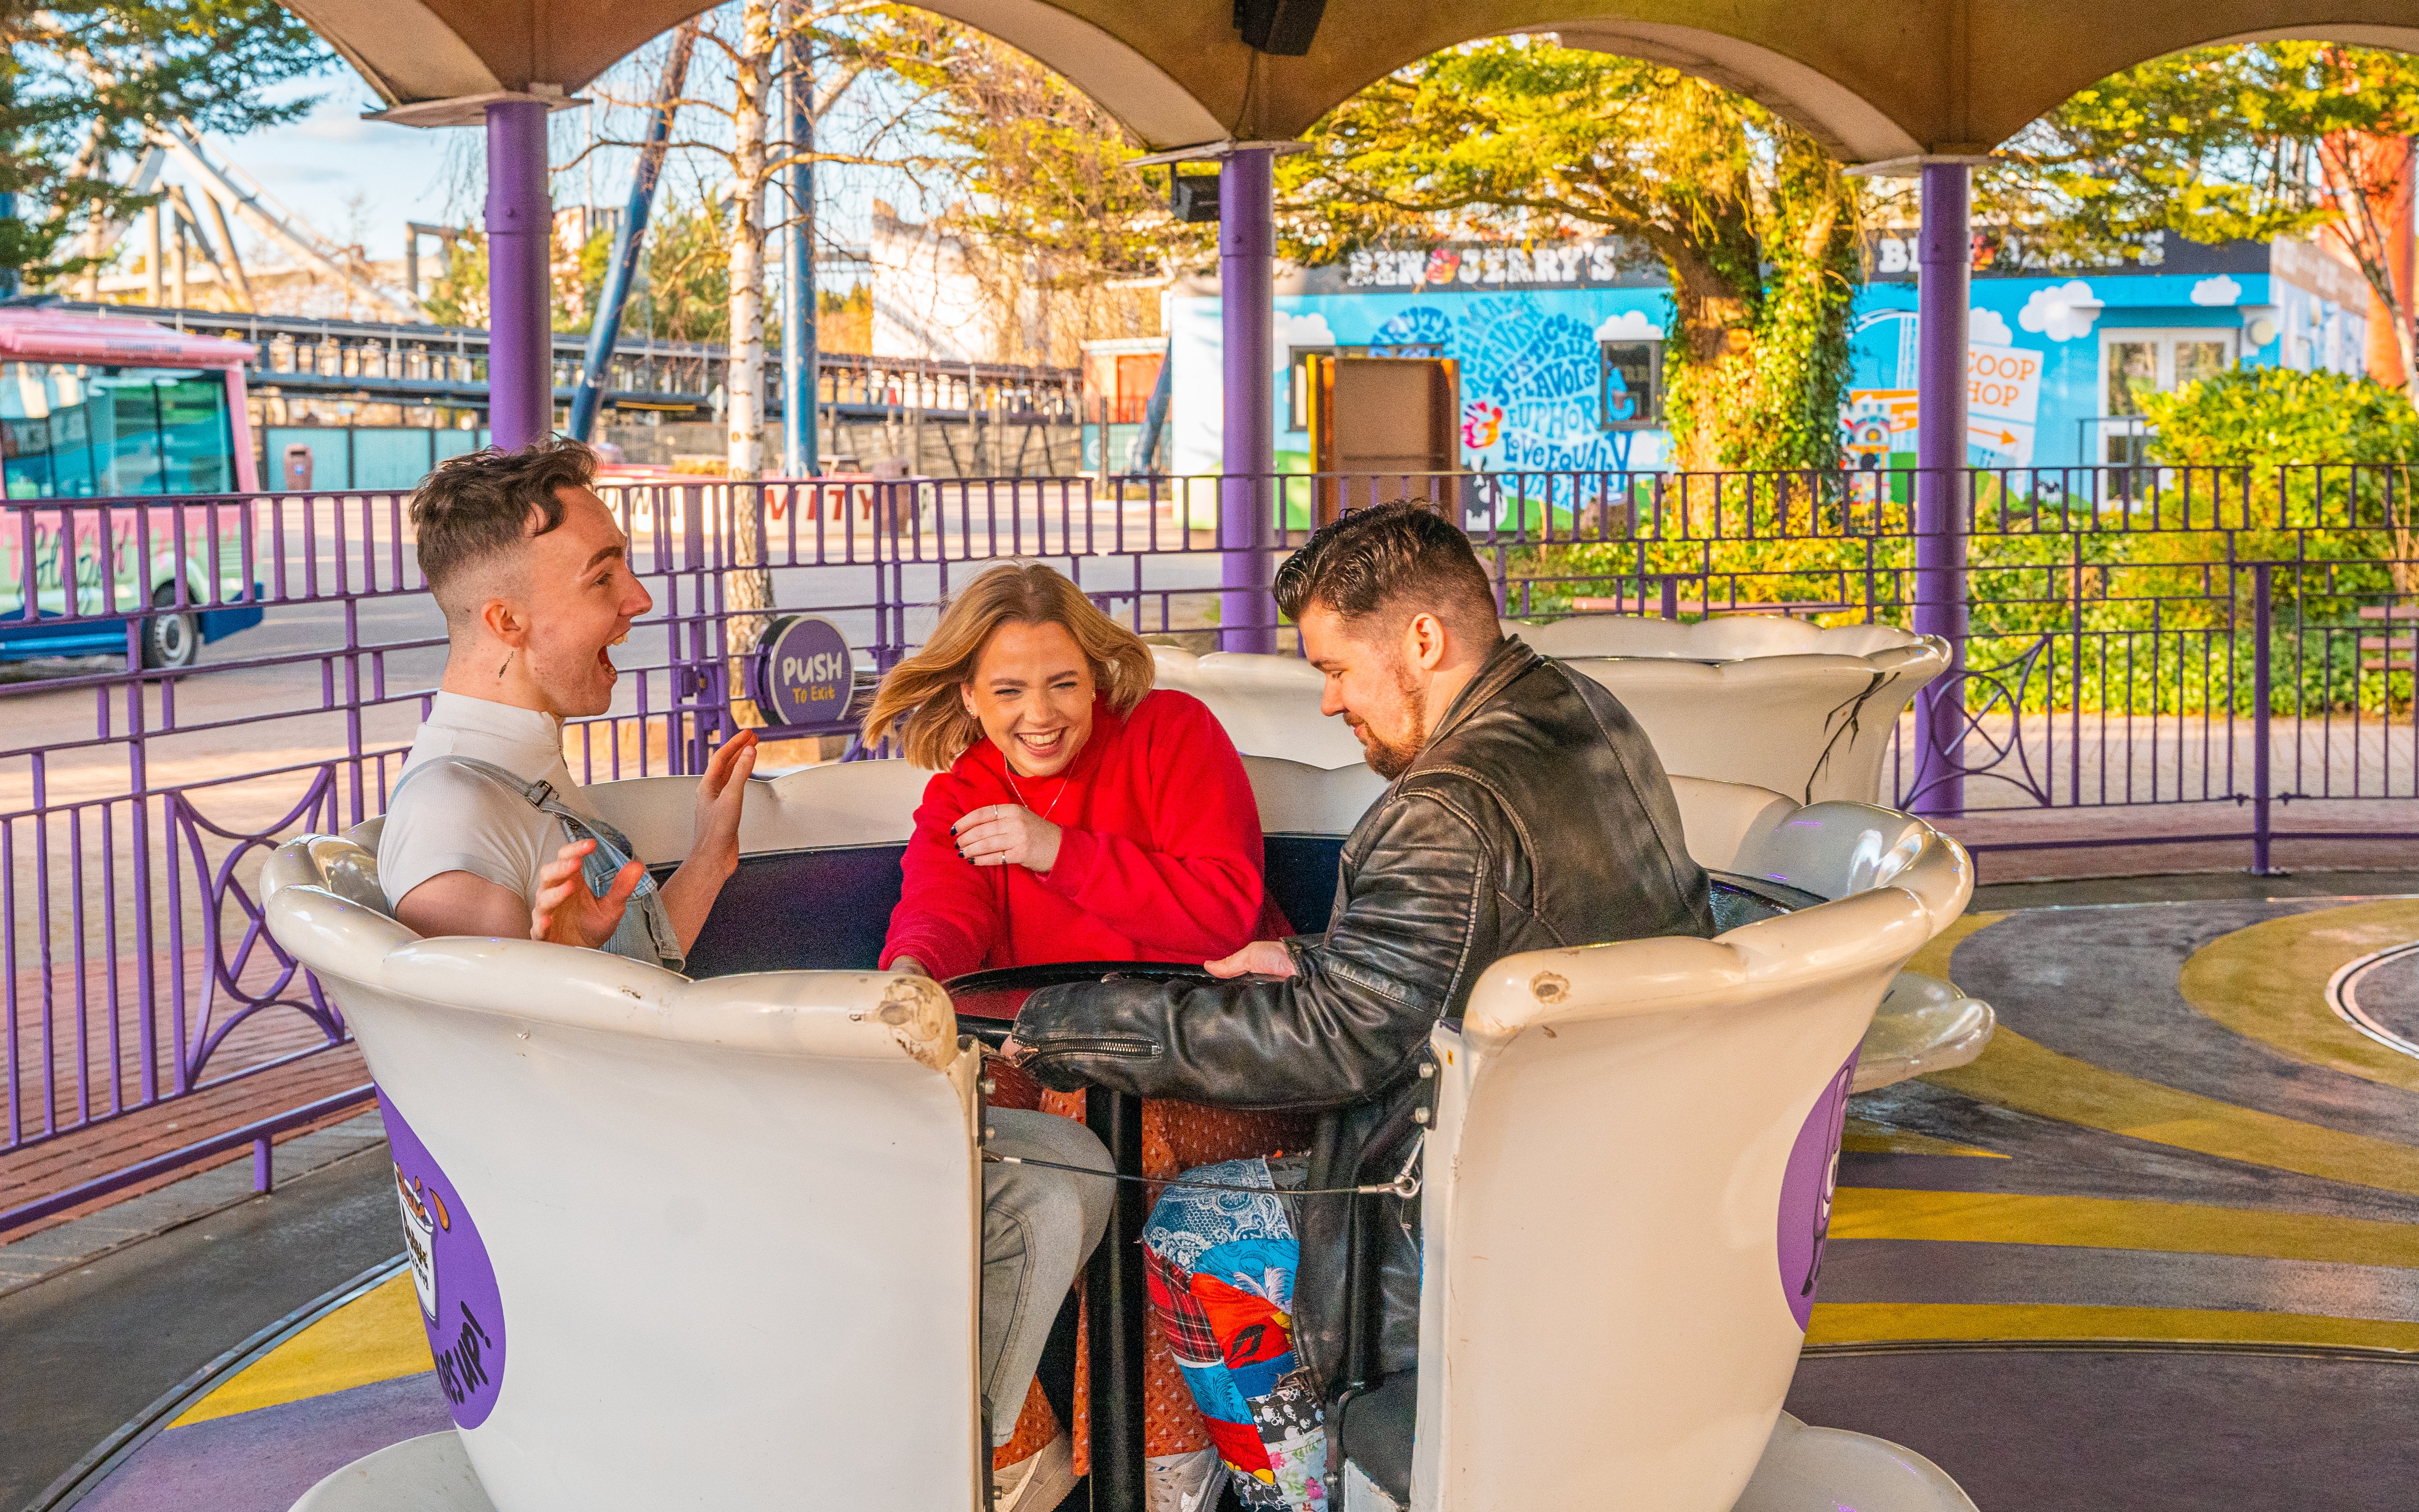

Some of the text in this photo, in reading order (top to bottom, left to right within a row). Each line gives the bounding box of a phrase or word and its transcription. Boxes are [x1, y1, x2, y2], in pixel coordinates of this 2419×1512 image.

[1347, 250, 1426, 286] BEN
[1967, 380, 2019, 407] HOP
[783, 652, 842, 686] PUSH
